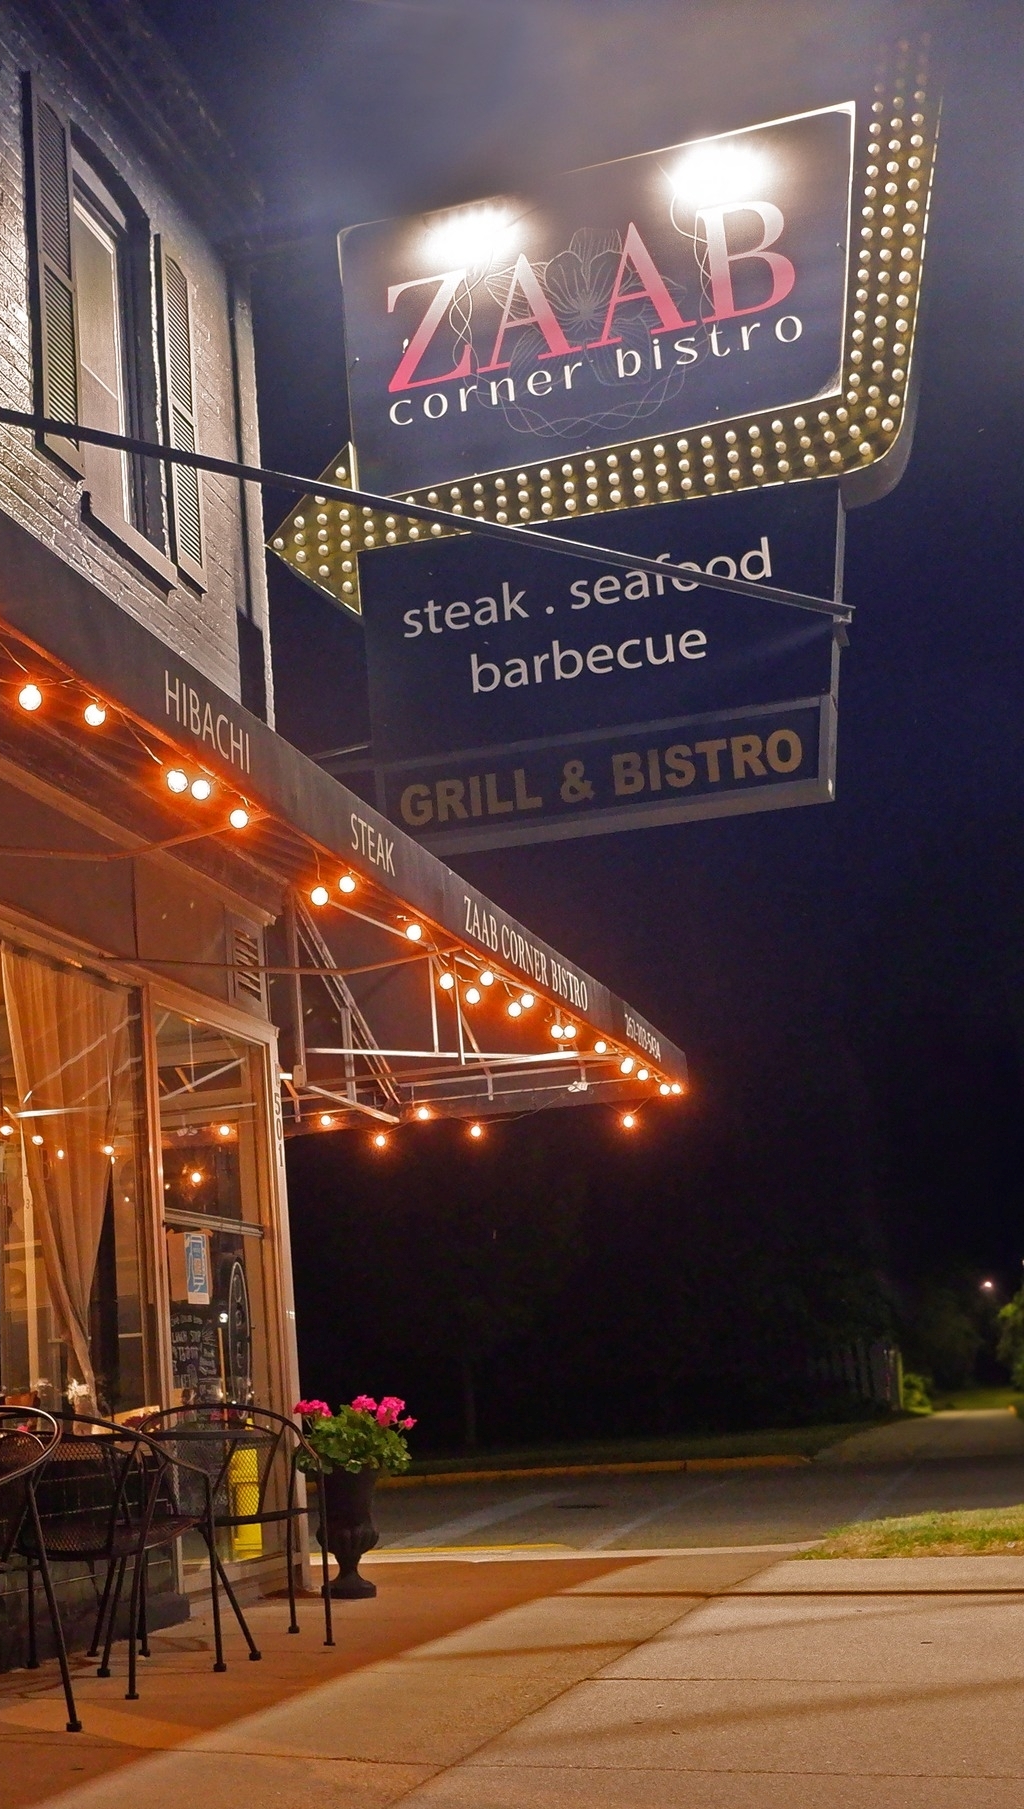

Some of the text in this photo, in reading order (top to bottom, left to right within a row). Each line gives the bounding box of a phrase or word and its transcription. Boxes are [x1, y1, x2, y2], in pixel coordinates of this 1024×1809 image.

[387, 200, 796, 394] ZAAB
[388, 315, 804, 427] corner bistro
[402, 582, 529, 638] steak
[569, 536, 773, 610] seafood
[470, 627, 709, 695] barbecue
[164, 669, 251, 774] HIBACHI
[399, 729, 803, 827] GRILL & BISTRO
[349, 812, 396, 877] STEAK
[463, 895, 588, 1012] ZAAB CORNER BISTRO
